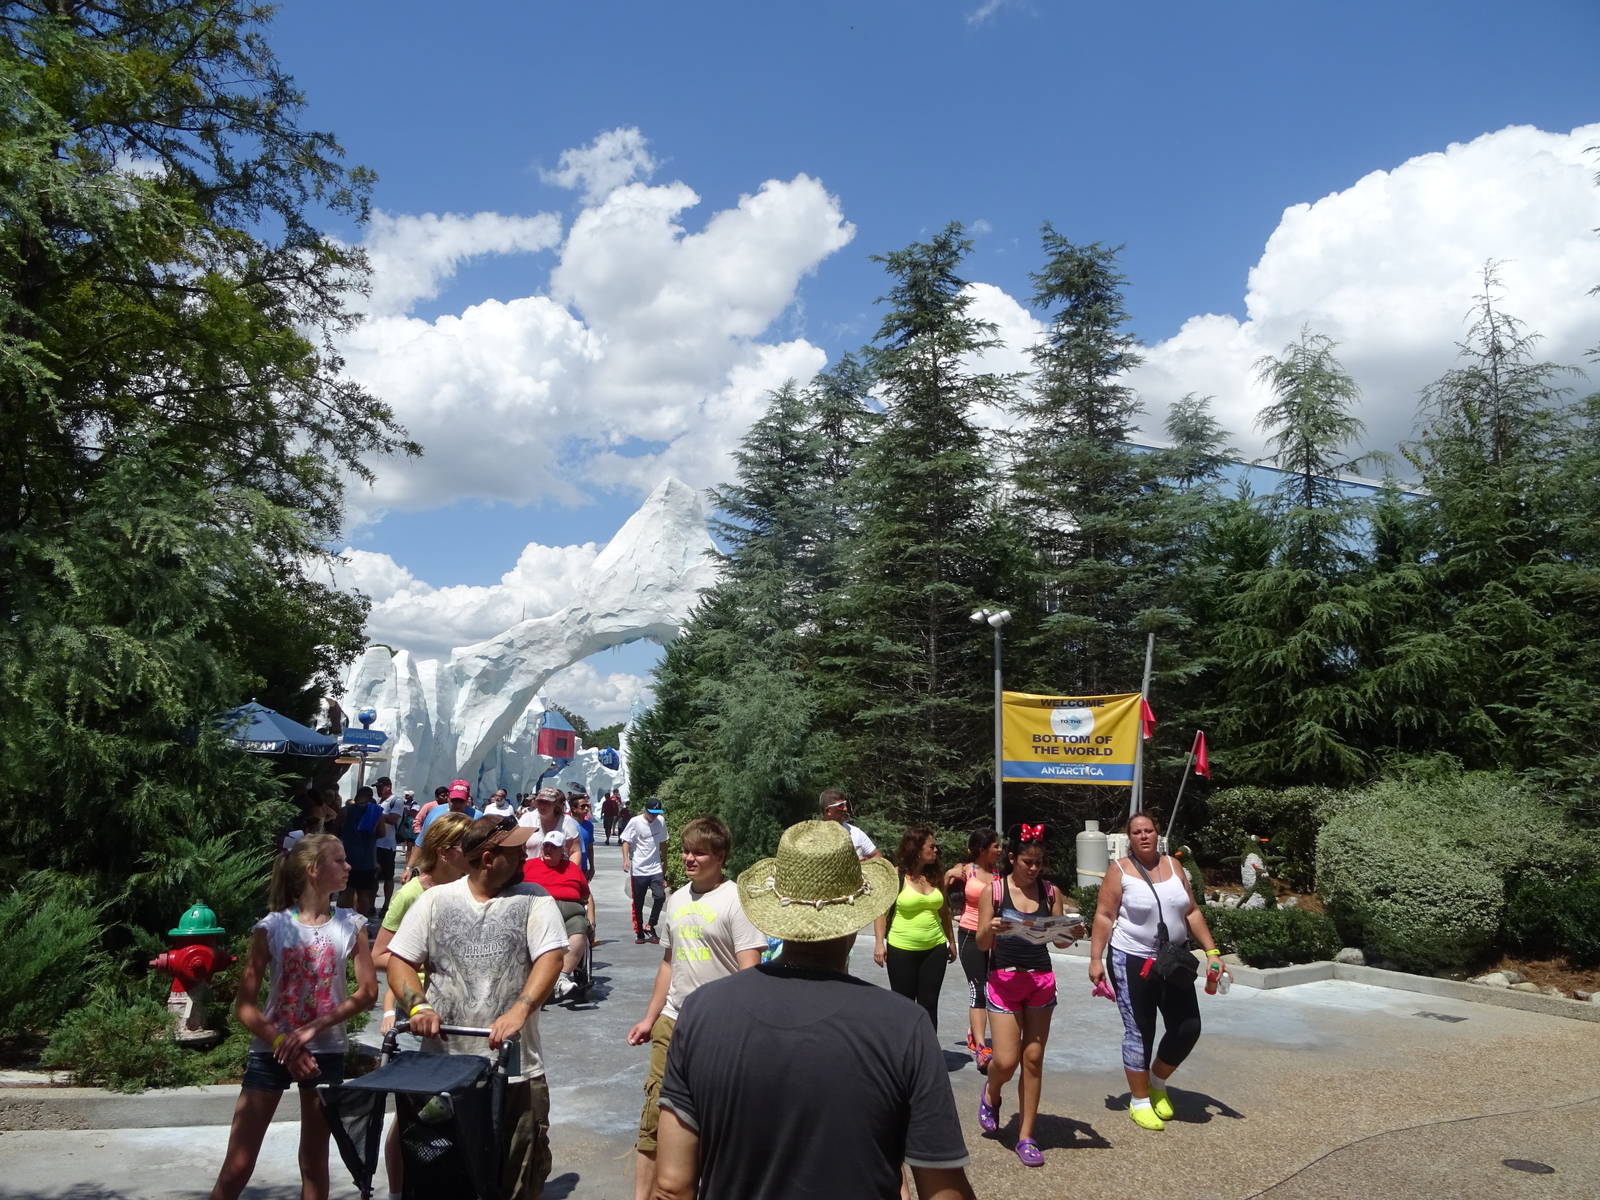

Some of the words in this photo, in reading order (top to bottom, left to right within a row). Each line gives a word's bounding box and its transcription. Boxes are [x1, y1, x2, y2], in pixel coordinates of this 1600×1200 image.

[1041, 699, 1104, 708] WELCOME
[1032, 734, 1090, 744] BOTTOM
[1095, 735, 1113, 745] OF
[1032, 745, 1060, 755] THE
[1063, 746, 1113, 756] WORLD
[464, 942, 504, 954] PRIMOS
